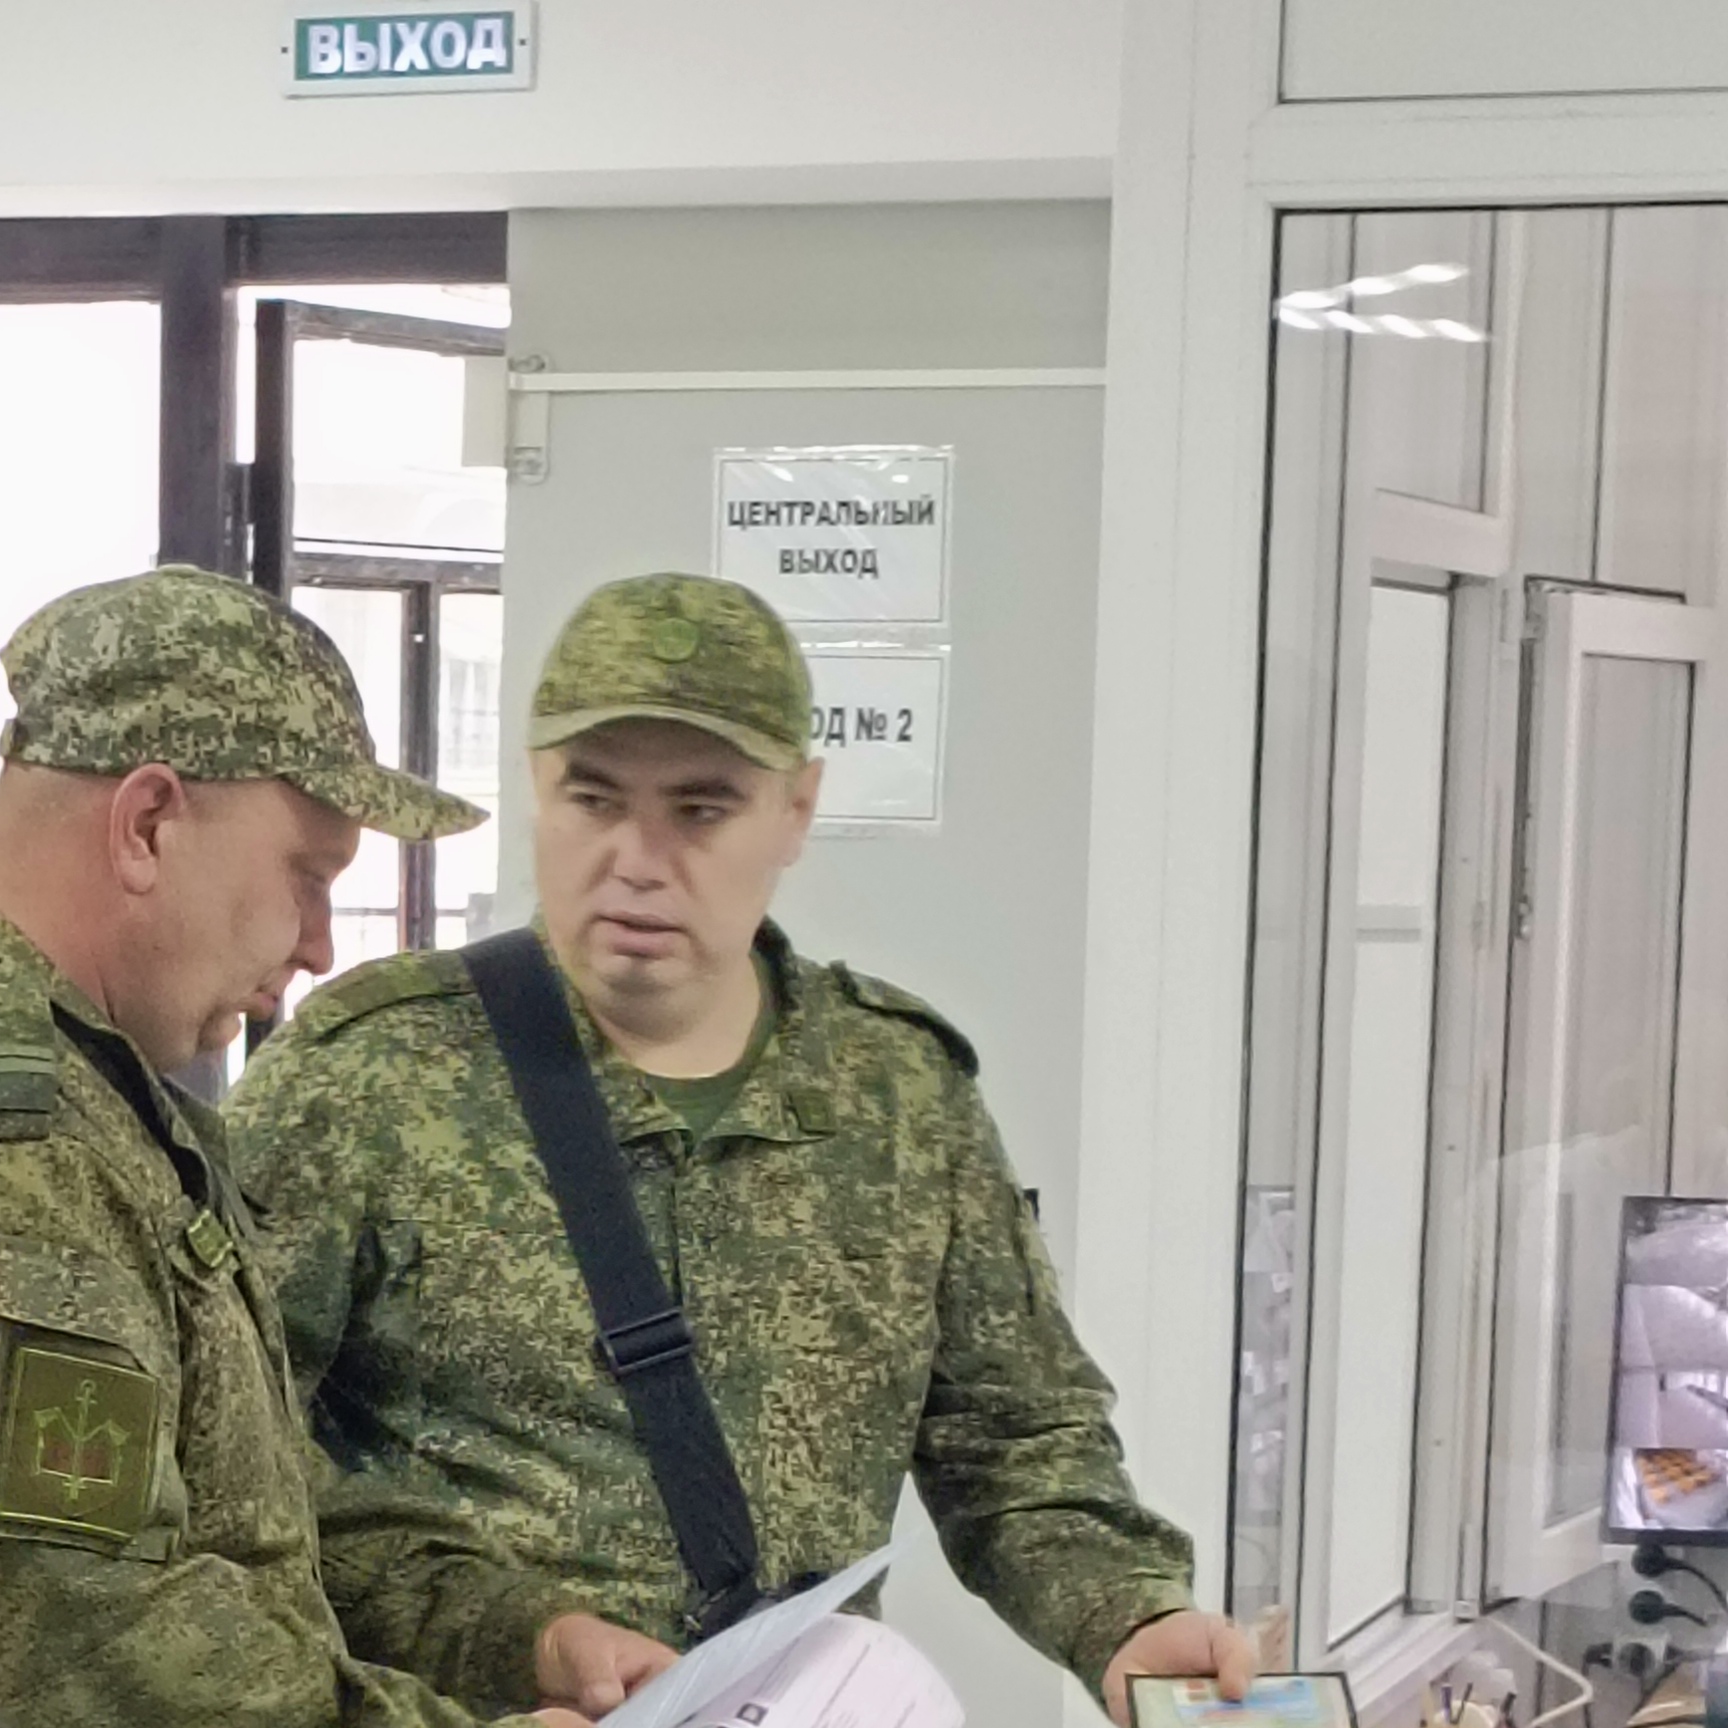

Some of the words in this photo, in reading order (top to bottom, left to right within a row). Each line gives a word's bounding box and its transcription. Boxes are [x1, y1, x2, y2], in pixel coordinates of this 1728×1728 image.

[307, 18, 508, 75] ВЫХОД
[727, 495, 935, 530] ЦЕНТРАЛЬНЫЙ
[779, 549, 879, 579] ВЫХОД
[810, 706, 847, 748] ОД
[855, 707, 888, 742] №
[896, 708, 913, 743] 2
